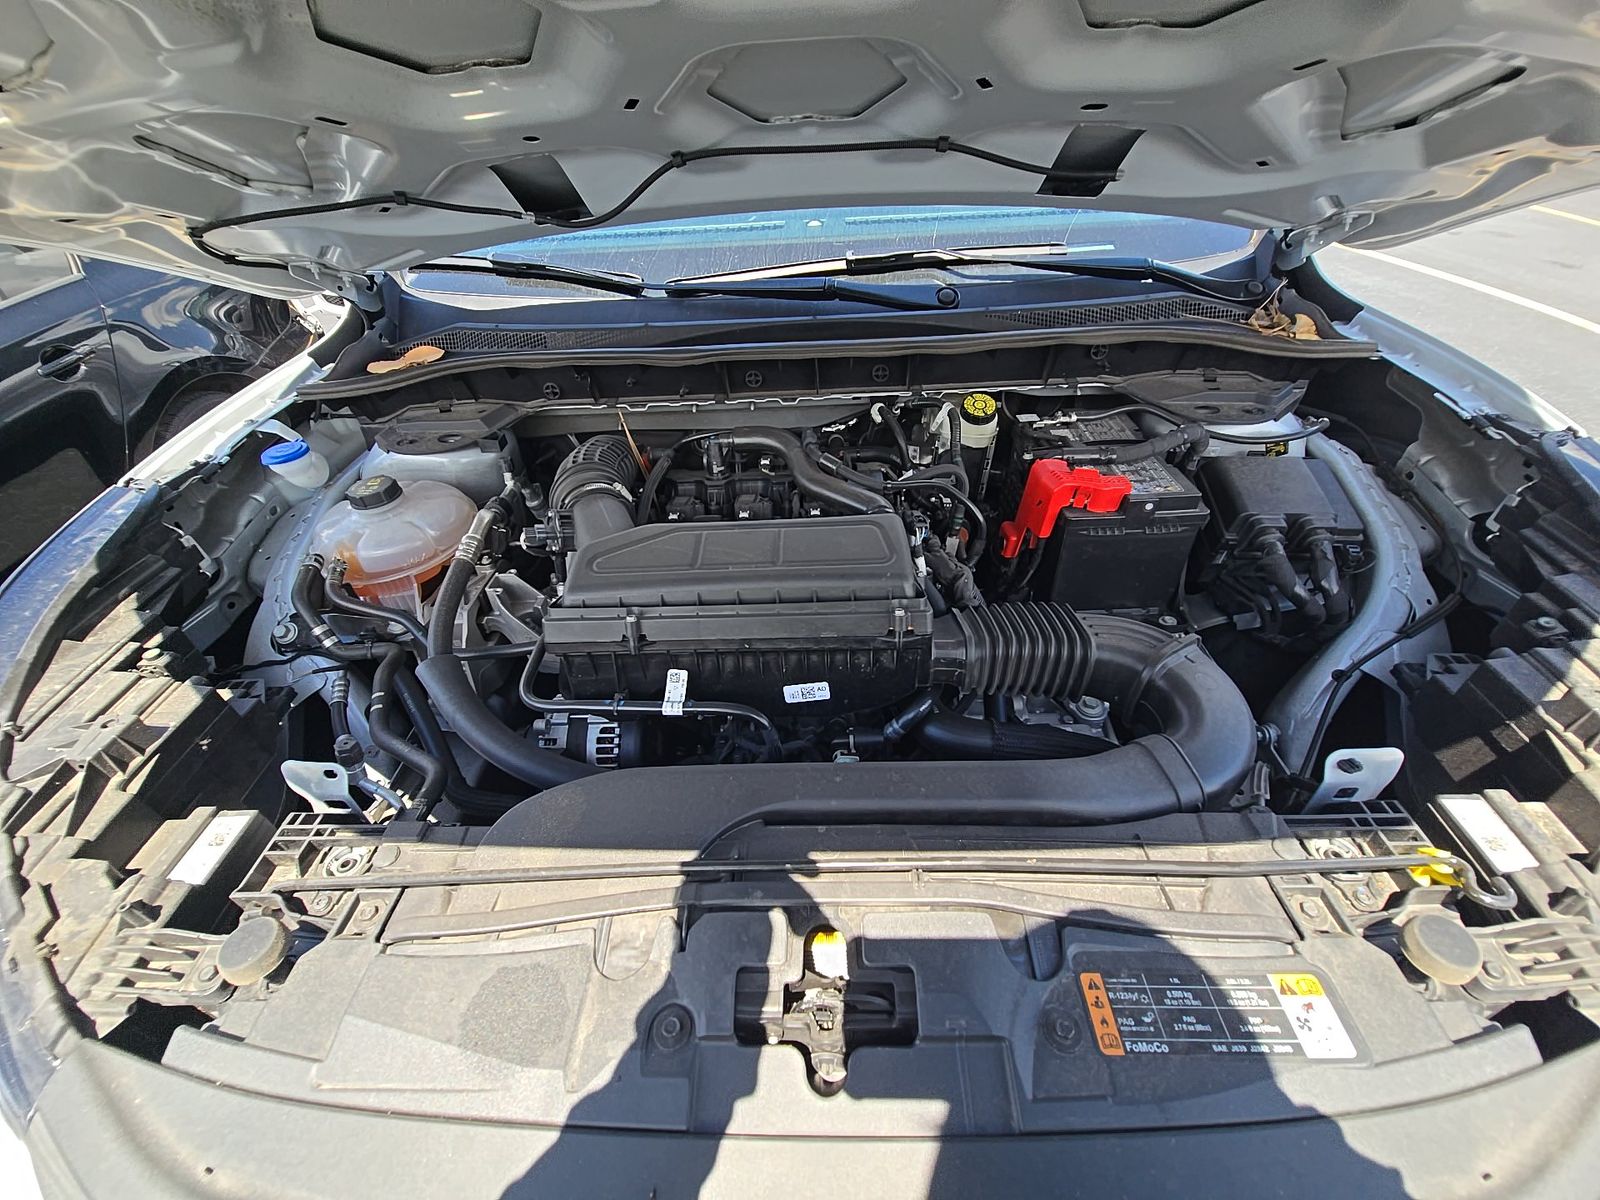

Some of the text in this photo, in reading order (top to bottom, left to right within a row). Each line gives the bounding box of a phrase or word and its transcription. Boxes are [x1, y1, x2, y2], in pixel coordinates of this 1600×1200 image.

[1117, 1017, 1135, 1026] PAG
[1182, 1015, 1196, 1023] PAG
[1124, 1041, 1170, 1053] FoMoCo
